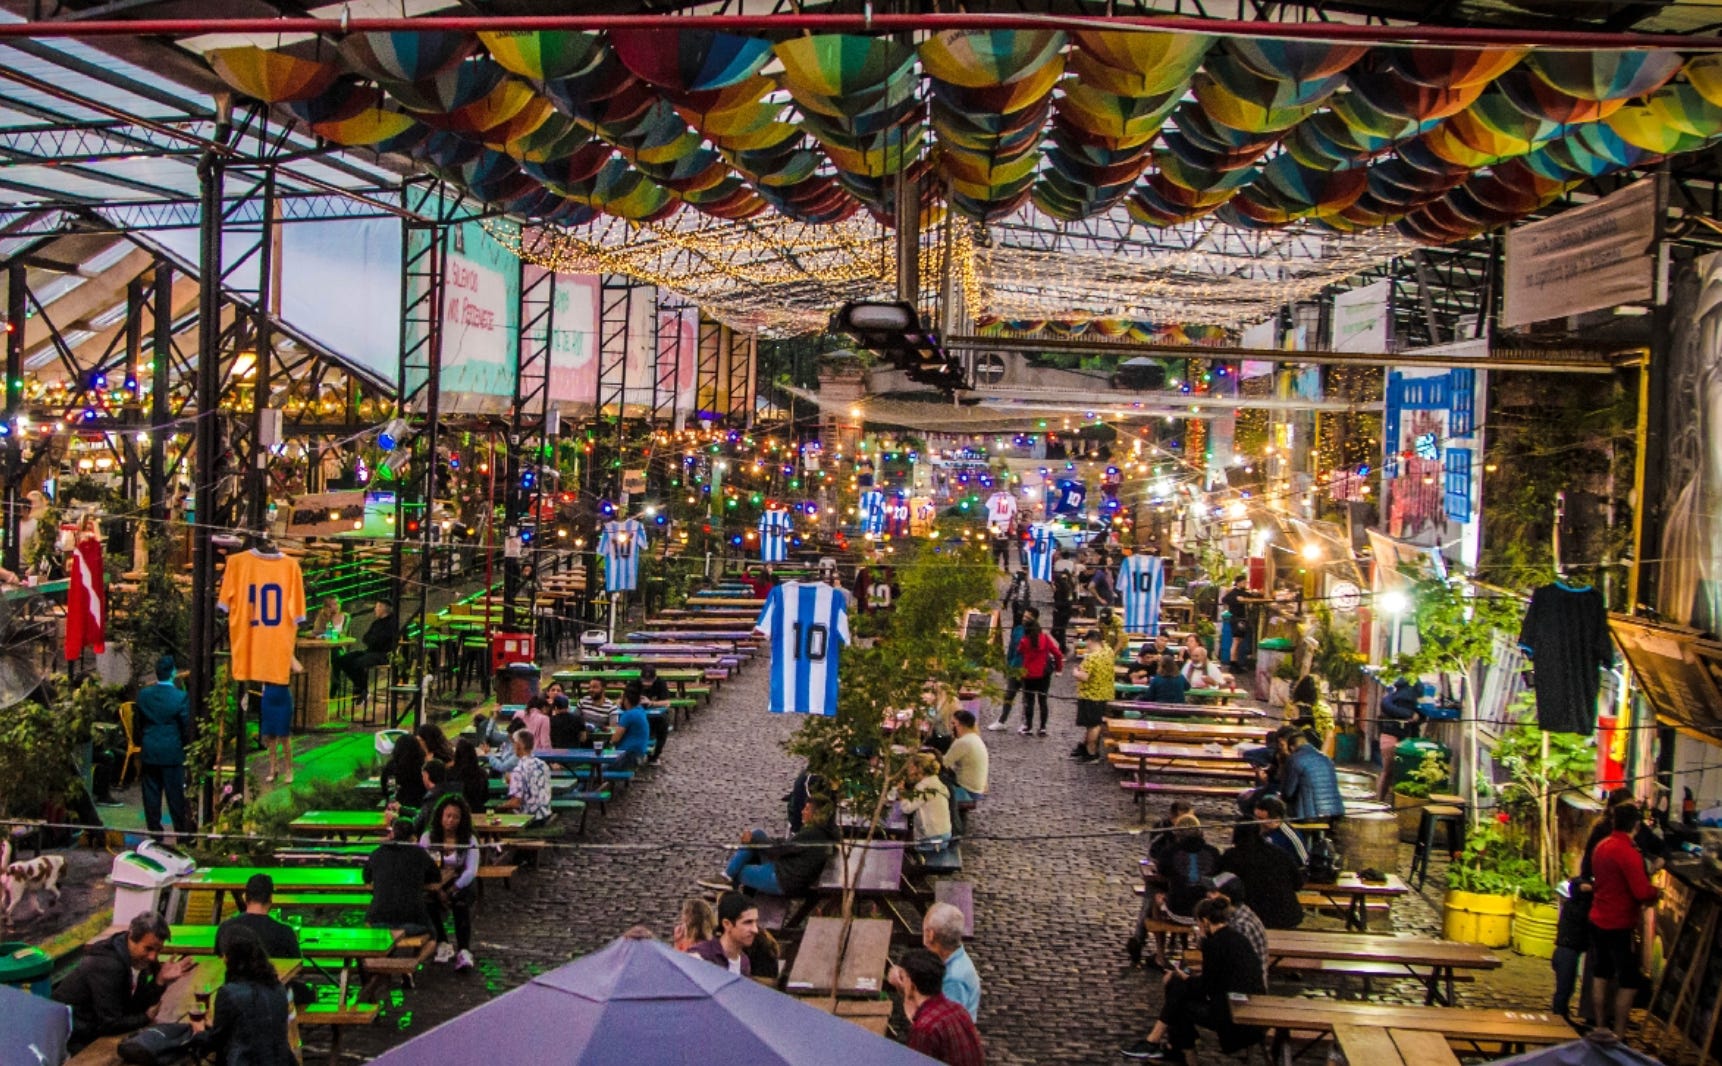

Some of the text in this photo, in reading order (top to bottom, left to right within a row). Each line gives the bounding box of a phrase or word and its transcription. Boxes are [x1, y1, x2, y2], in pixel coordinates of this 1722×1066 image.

[997, 499, 1008, 514] 10
[1067, 491, 1083, 507] 10
[893, 506, 908, 520] 10
[1133, 571, 1153, 592] 10
[248, 584, 283, 627] 10
[868, 584, 891, 607] 10
[793, 622, 828, 662] 10
